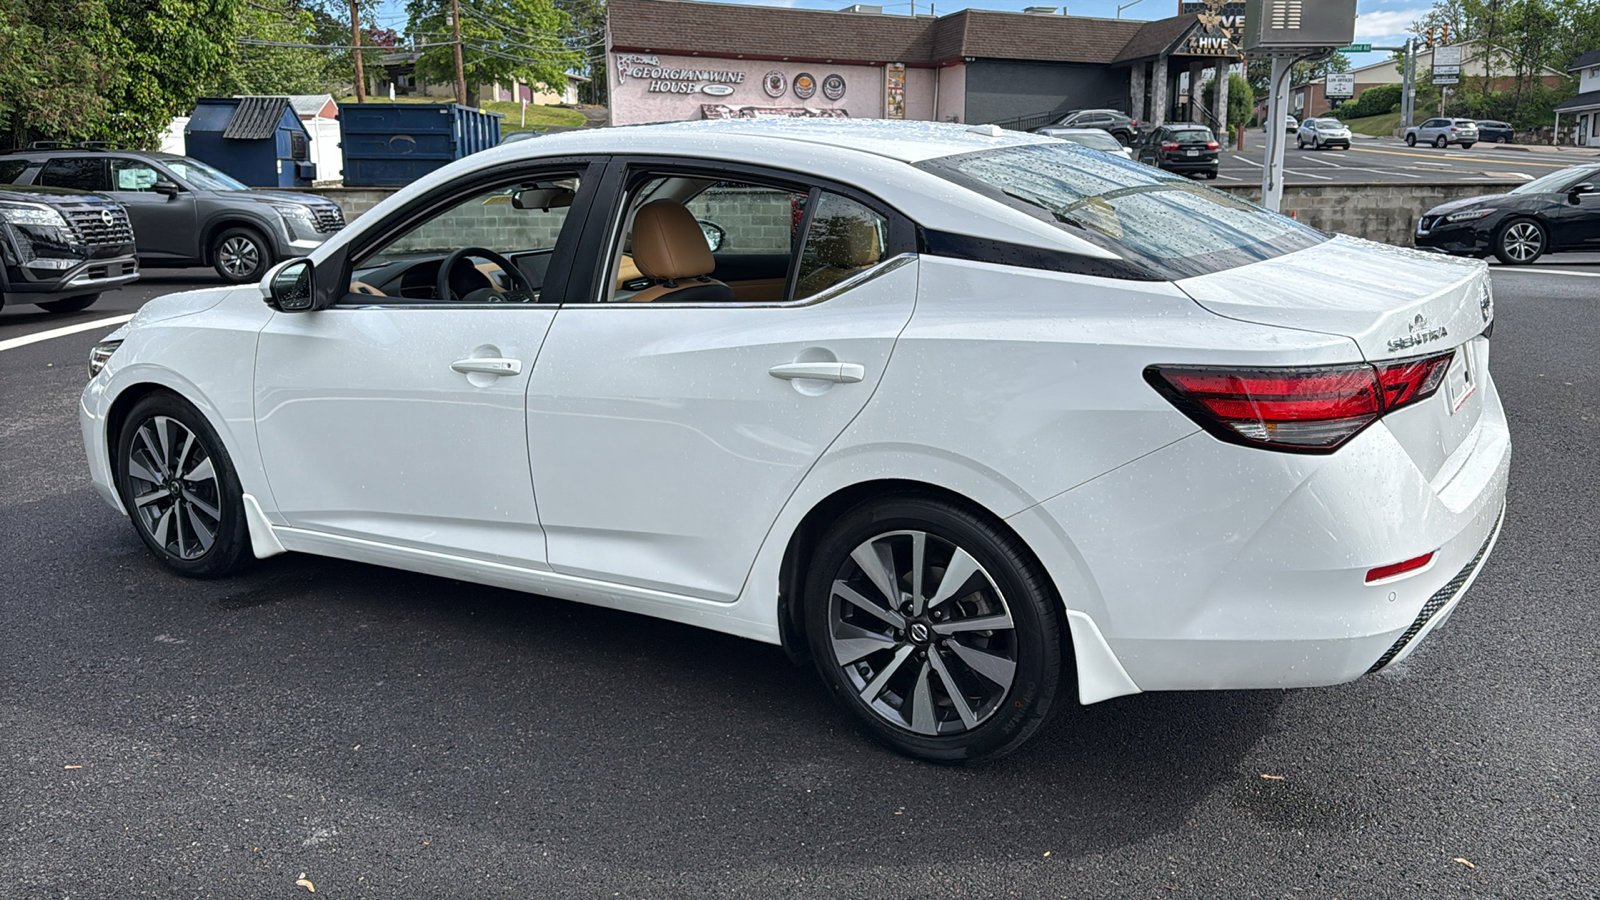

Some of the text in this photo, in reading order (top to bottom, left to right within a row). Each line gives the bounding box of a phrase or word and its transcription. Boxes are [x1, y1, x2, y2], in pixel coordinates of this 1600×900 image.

[1199, 37, 1229, 49] HIVE
[632, 67, 745, 83] GEORGIAN WINE
[649, 81, 696, 94] HOUSE
[1386, 326, 1448, 352] SENTRA
